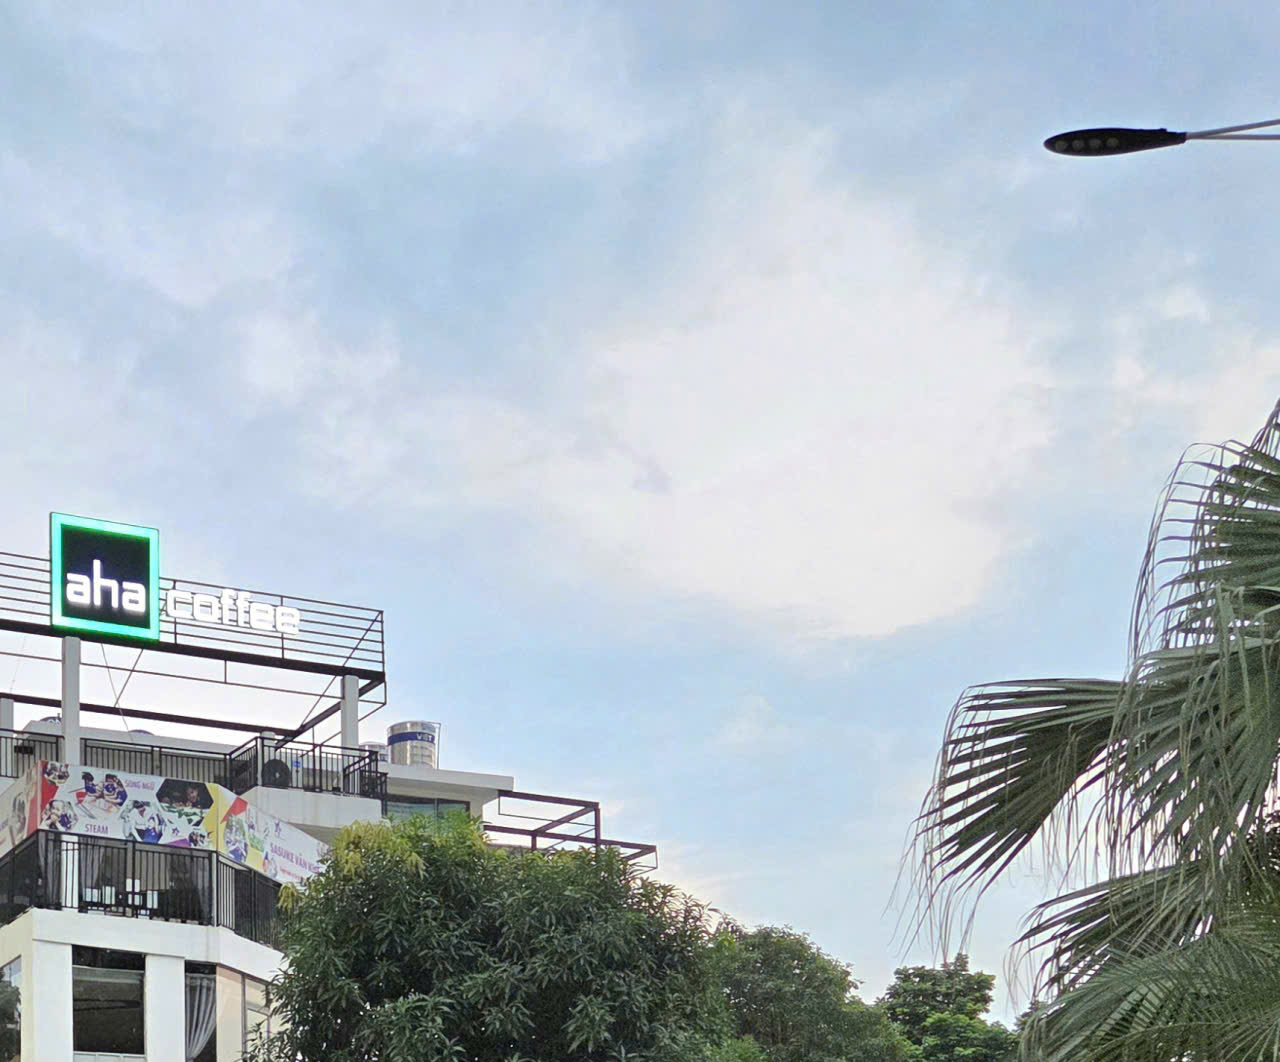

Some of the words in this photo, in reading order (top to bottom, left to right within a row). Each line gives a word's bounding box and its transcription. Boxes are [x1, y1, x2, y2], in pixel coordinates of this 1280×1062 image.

[66, 559, 146, 613] aha
[166, 588, 301, 635] coffee
[85, 824, 109, 834] STEAM
